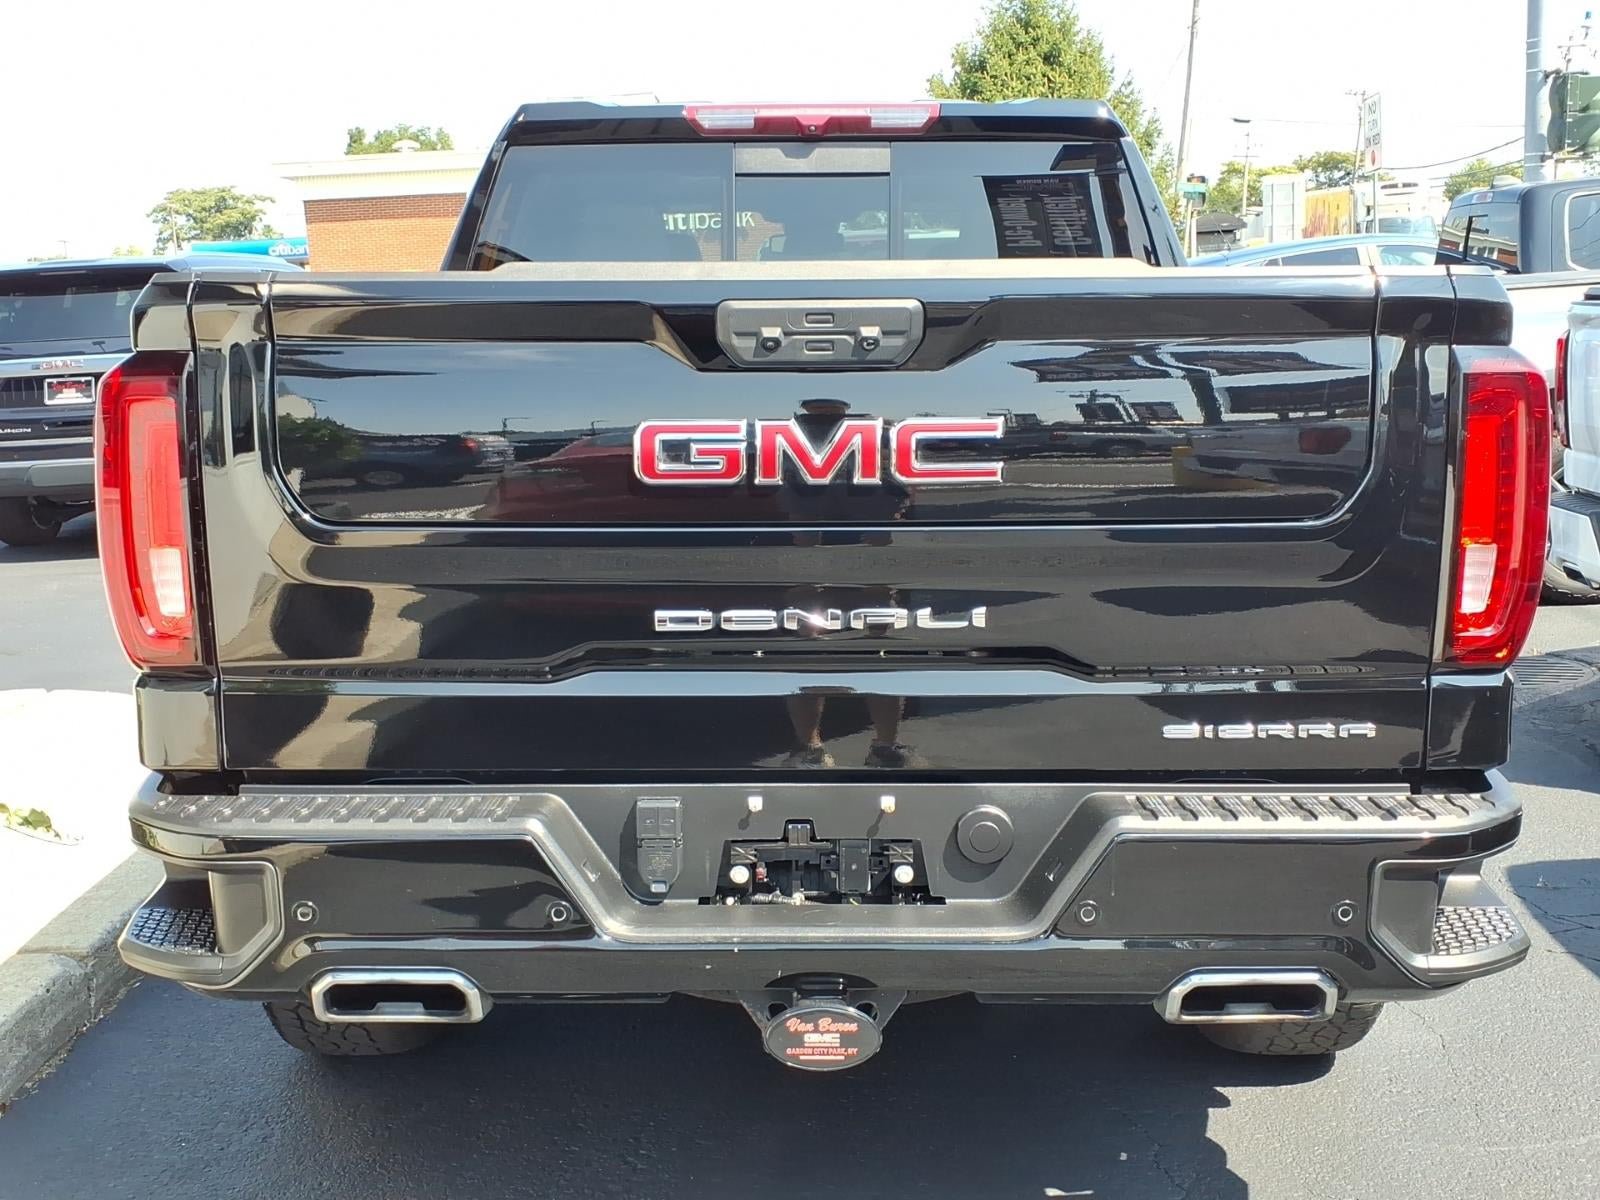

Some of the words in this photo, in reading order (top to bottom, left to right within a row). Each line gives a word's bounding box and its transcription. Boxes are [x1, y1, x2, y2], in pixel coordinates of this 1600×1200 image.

[634, 416, 1005, 485] GMC
[654, 606, 987, 632] DENALI
[1162, 721, 1377, 739] SIERRA
[786, 1017, 815, 1032] Van
[818, 1017, 858, 1032] Buren
